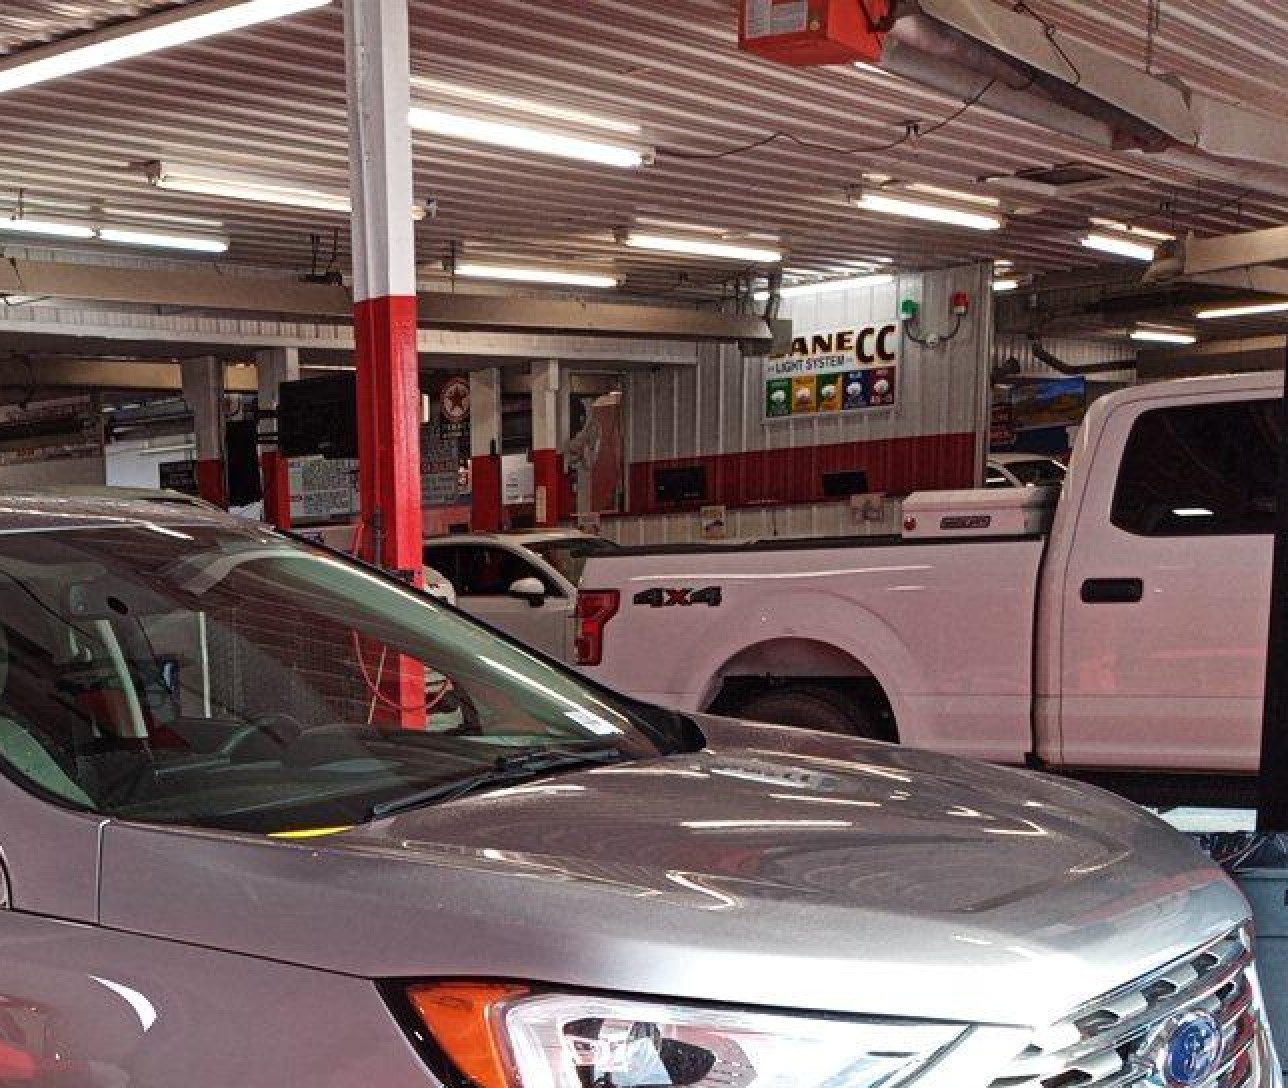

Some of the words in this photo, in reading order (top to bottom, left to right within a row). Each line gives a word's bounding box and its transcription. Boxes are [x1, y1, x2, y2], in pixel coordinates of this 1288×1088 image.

[768, 331, 854, 358] ANE
[775, 359, 805, 374] LIGHT
[805, 355, 845, 371] SYSTEM
